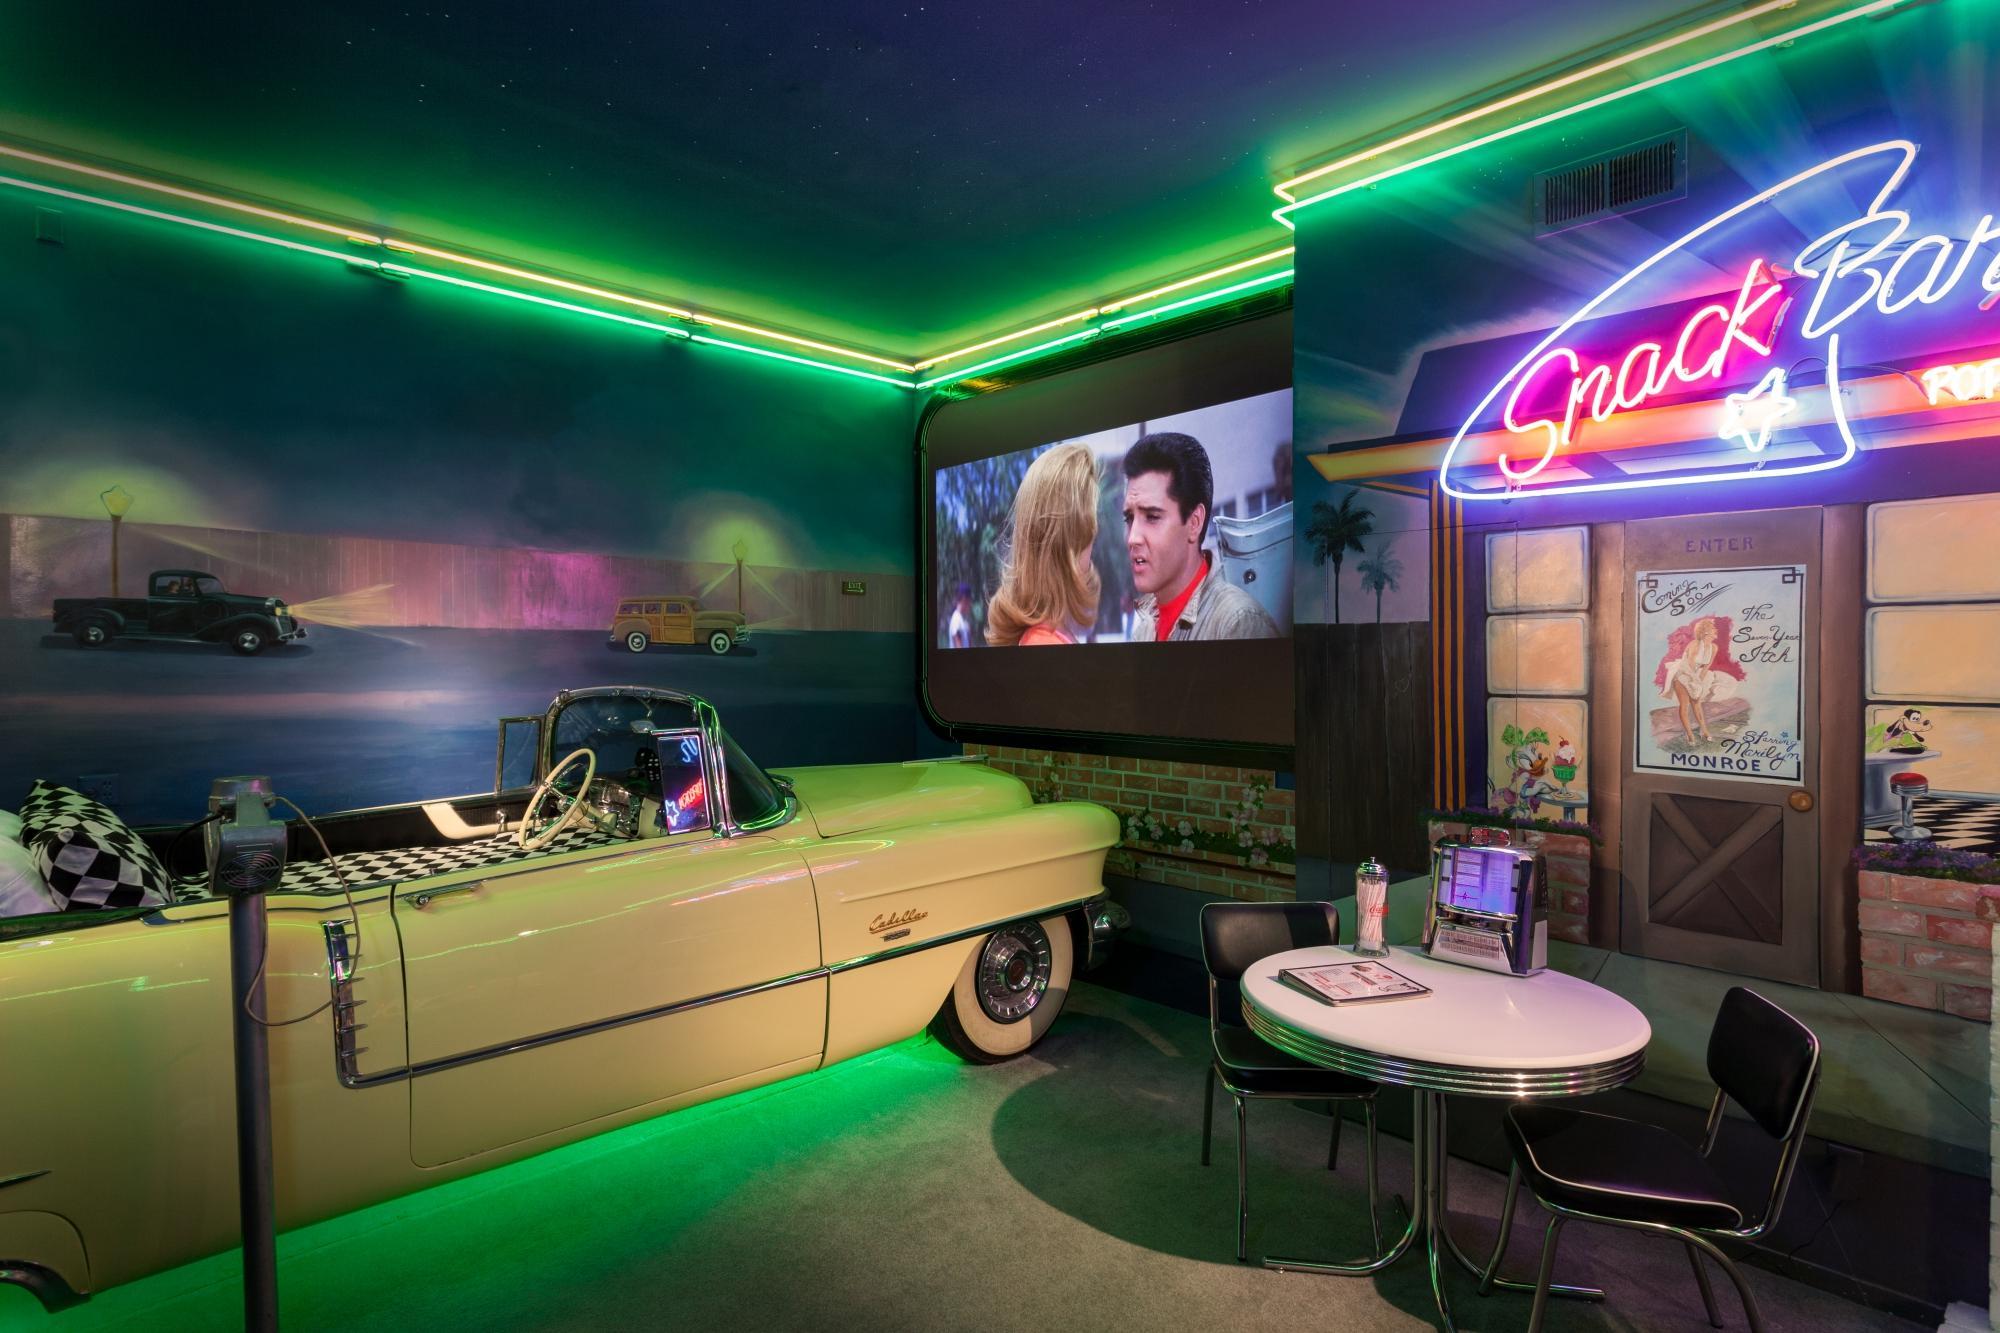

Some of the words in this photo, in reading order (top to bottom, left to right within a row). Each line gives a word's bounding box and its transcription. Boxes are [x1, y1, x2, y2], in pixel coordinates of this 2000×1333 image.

[1498, 257, 1784, 481] Snack
[1686, 536, 1753, 553] ENTER
[1641, 580, 1698, 613] Coming
[1670, 582, 1716, 616] Soon
[1742, 603, 1775, 621] The
[1739, 642, 1794, 663] Itch
[1742, 730, 1798, 752] Starring
[1671, 753, 1761, 772] MONROE
[1721, 738, 1800, 770] Marilyn
[869, 908, 929, 933] Cadillac
